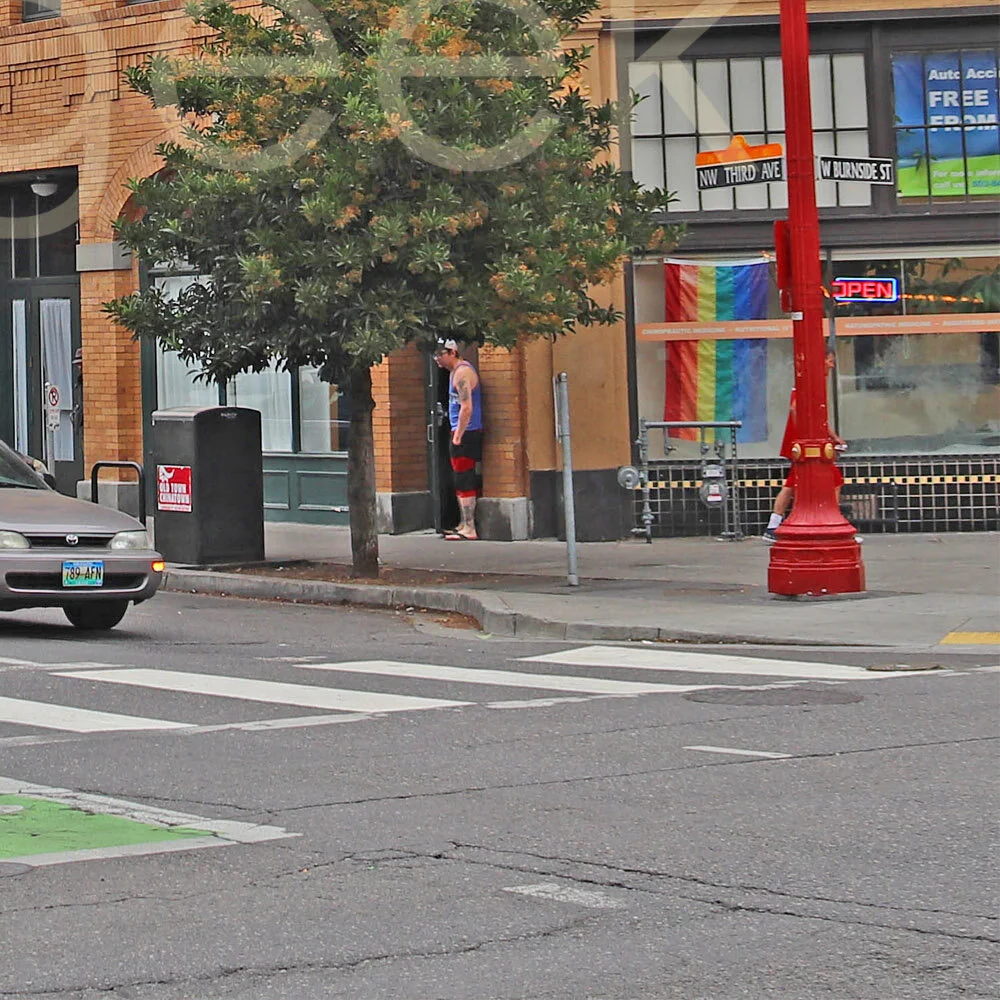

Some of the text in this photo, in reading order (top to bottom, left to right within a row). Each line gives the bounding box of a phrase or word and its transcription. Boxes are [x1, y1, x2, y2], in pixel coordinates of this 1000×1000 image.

[966, 67, 1000, 79] Acci
[928, 89, 989, 107] FREE
[930, 114, 997, 131] FROM
[700, 161, 781, 187] NW THIRD AVE
[821, 161, 892, 180] W BURNSIDE ST
[832, 281, 892, 298] OPEN
[65, 566, 101, 580] 789 AFN
